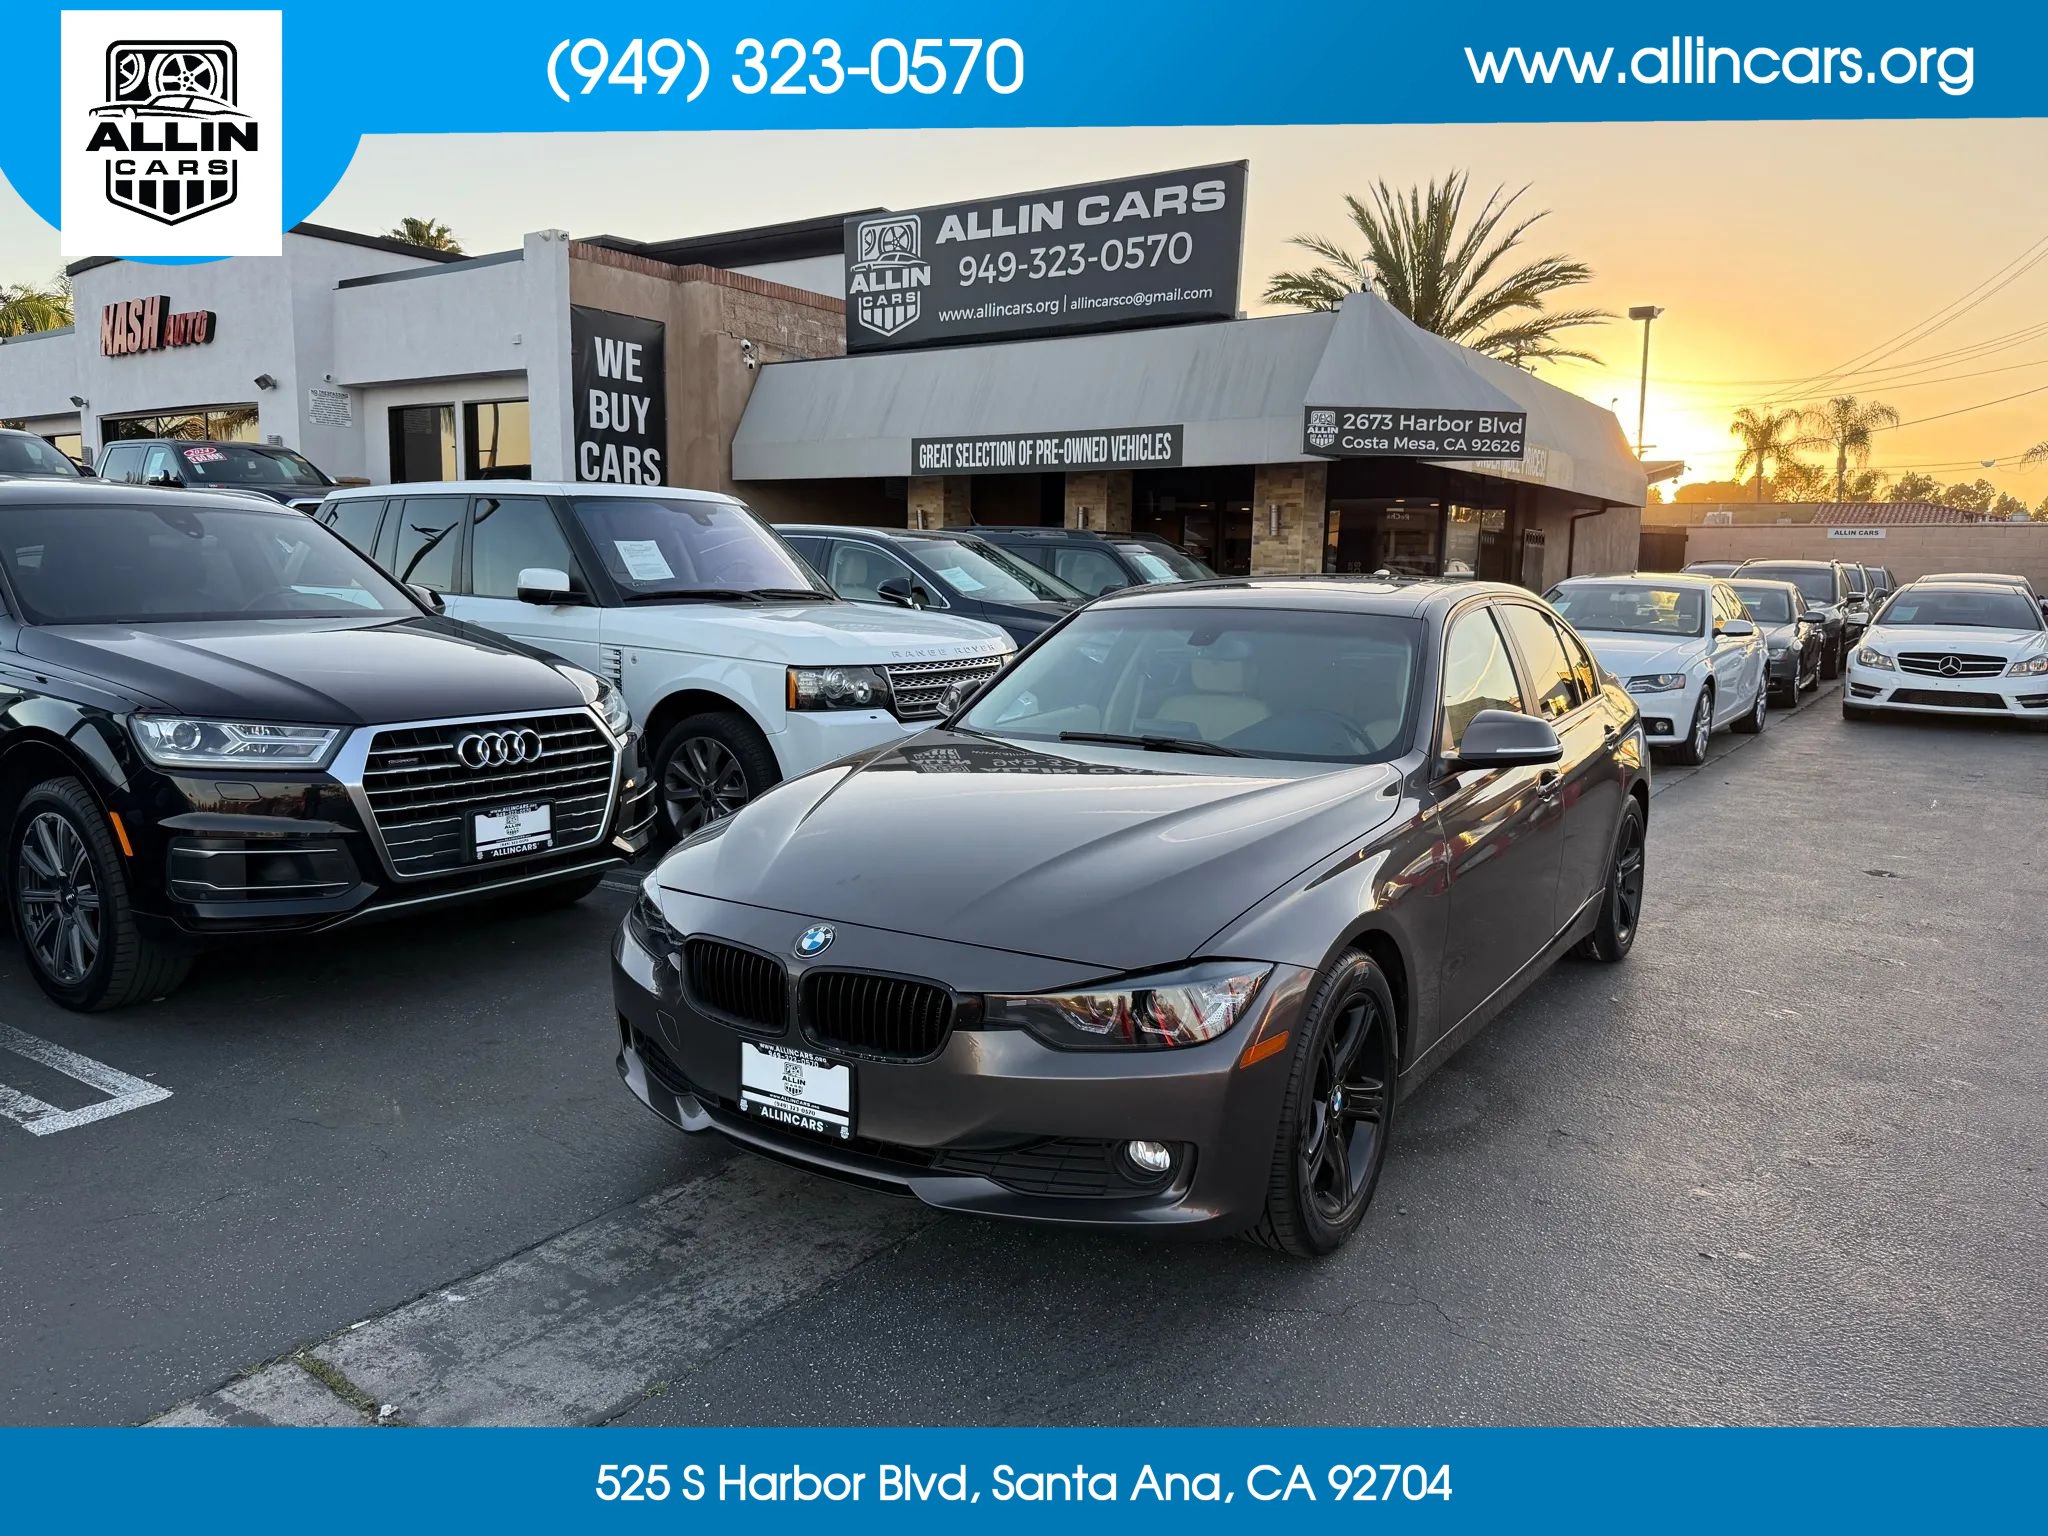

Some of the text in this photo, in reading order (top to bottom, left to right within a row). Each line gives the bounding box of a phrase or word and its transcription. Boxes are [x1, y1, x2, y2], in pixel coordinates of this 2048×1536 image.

[936, 180, 1226, 244] ALLIN CARS
[959, 231, 1193, 287] 949-323-0570
[849, 265, 931, 294] ALLIN
[863, 292, 916, 307] CARS
[938, 288, 1213, 322] www.allincars.org allincarsco@gmail.com
[594, 336, 643, 383] WE
[589, 389, 651, 435] BUY
[1343, 413, 1522, 434] 2673 Harbor Blvd
[1307, 426, 1339, 434] ALLIN
[919, 432, 1172, 469] GREAT SELECTION OF PRE-OWNED VEHICLES
[1342, 436, 1521, 453] Costa Mesa, CA 92626
[580, 441, 661, 487] CARS
[891, 644, 996, 658] RANGE ROVER
[493, 842, 538, 857] ALLINCARS
[782, 1075, 806, 1086] ALLIN
[761, 1105, 824, 1132] ALLINCARS
